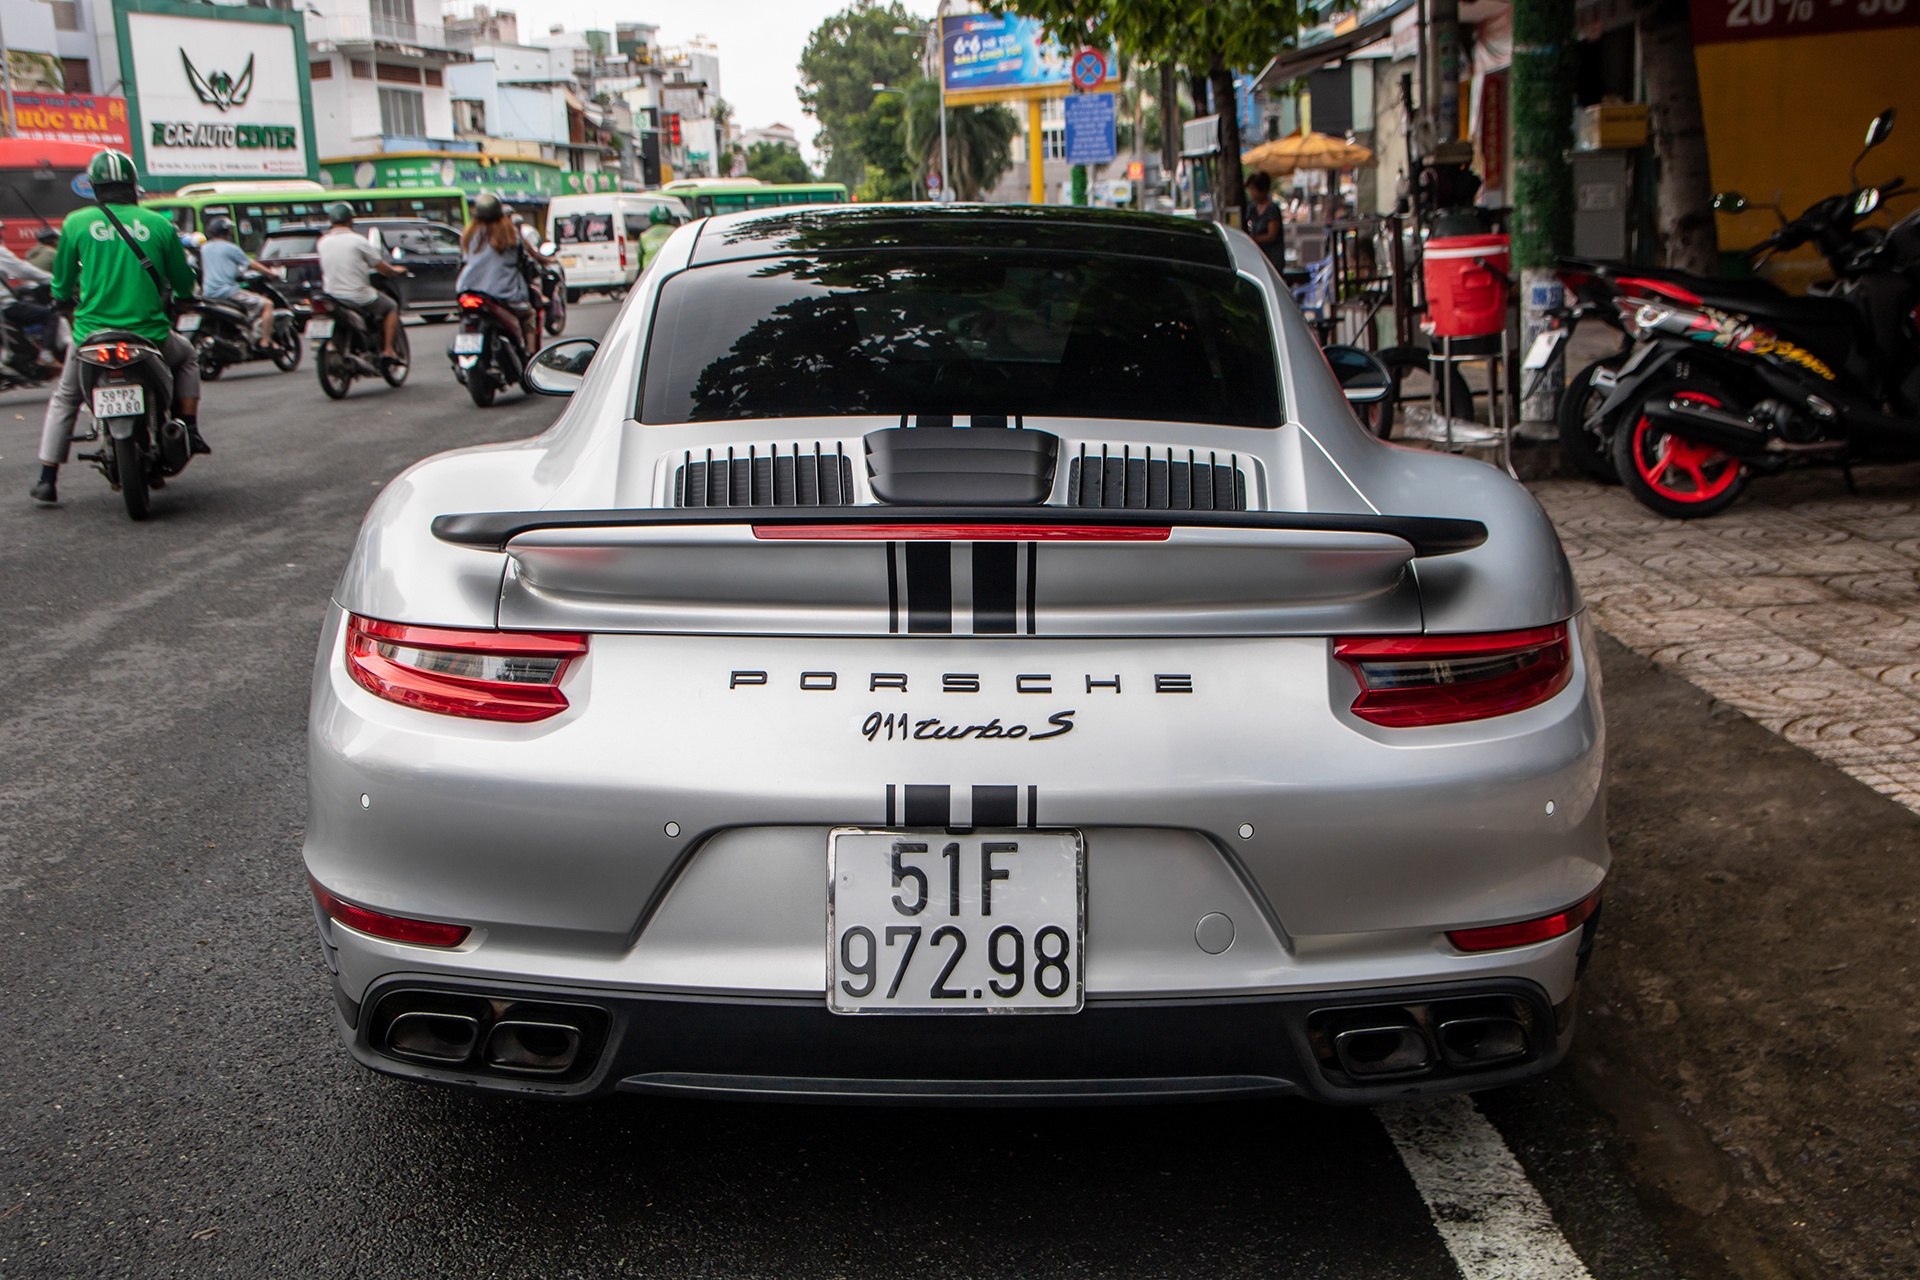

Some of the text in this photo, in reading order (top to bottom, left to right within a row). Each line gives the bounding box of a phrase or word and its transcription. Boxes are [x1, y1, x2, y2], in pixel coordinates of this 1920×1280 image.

[1725, 0, 1814, 27] 20%
[196, 123, 236, 148] AUTO
[236, 125, 297, 149] CENTER
[729, 670, 1194, 695] PORSCHE
[861, 710, 1076, 741] 911 turbo S
[891, 842, 1019, 917] 51F
[840, 925, 1071, 999] 972.98
